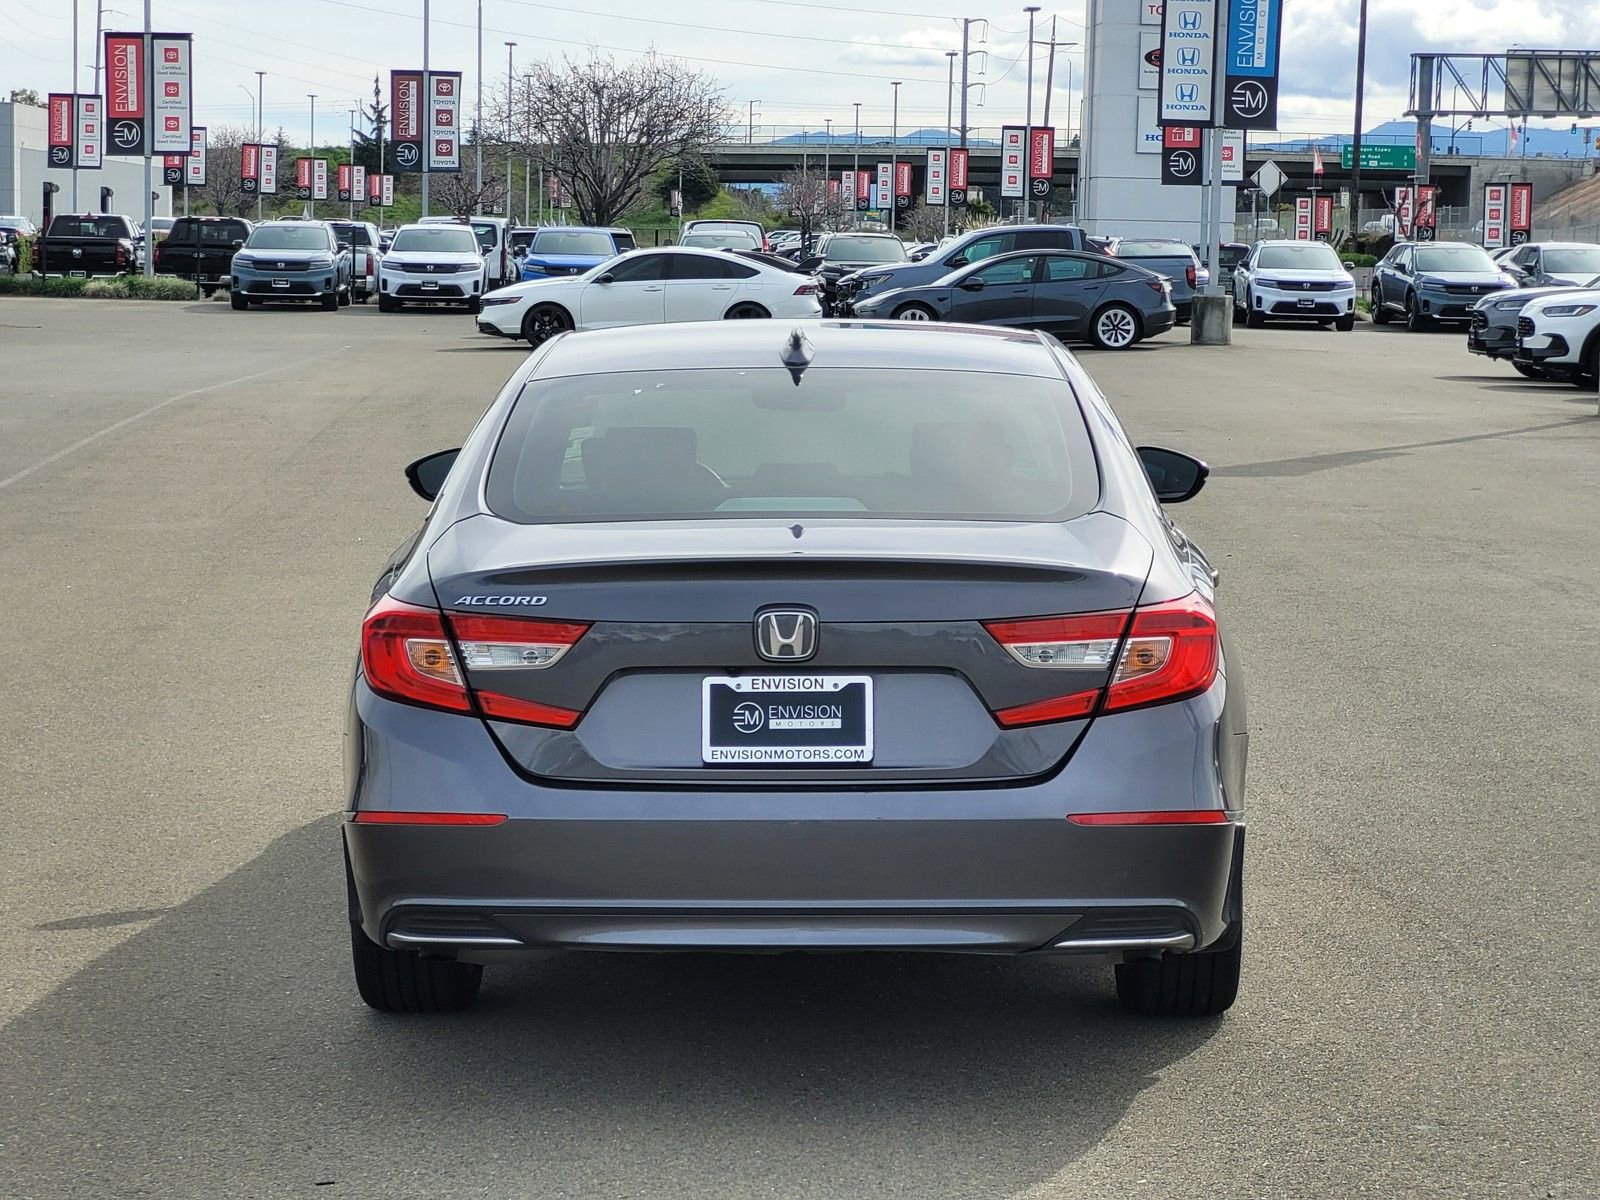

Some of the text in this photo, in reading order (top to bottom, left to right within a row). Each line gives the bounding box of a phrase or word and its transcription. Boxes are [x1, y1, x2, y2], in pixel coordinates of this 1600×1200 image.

[114, 44, 127, 112] ENVISION
[53, 100, 62, 142] ENVISION
[398, 80, 408, 136] ENVISION
[1034, 133, 1043, 174] ENVISION
[1513, 189, 1522, 227] ENVISION
[453, 595, 548, 606] ACCORD
[751, 678, 825, 690] ENVISION
[768, 705, 842, 719] ENVISION
[711, 749, 865, 760] ENVISIONMOTORS.COM
